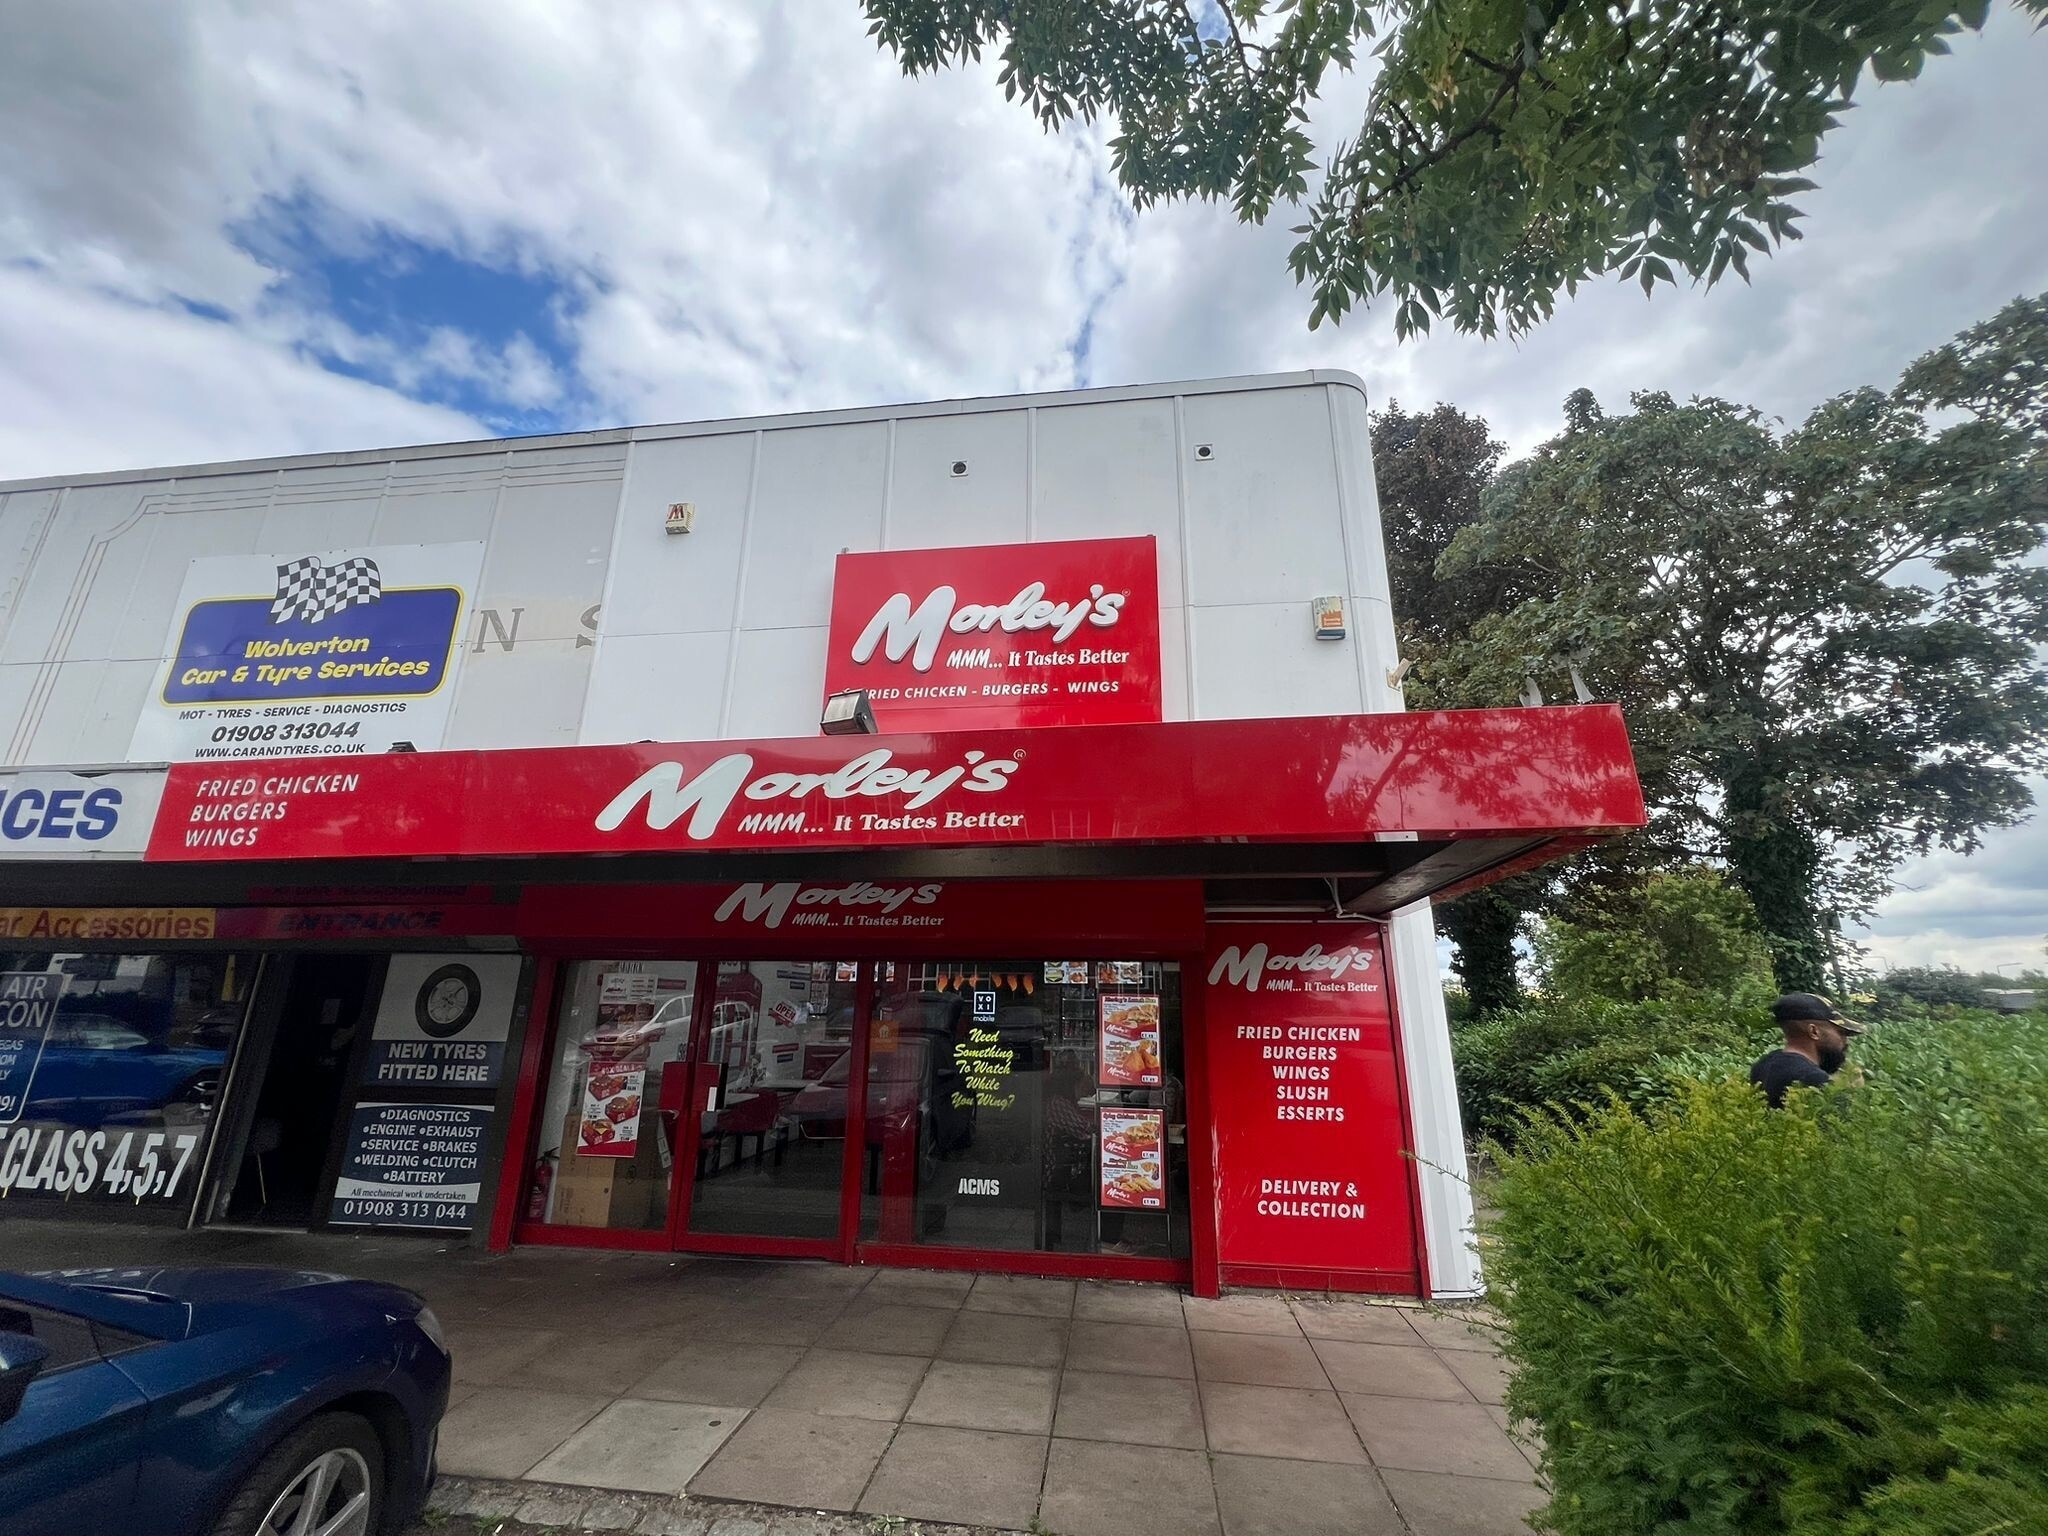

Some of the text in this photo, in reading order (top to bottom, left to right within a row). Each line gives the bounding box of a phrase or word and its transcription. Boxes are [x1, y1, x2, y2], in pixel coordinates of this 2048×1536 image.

[472, 608, 525, 653] N
[851, 581, 1126, 673] Morley's
[244, 636, 370, 658] Wolverton
[946, 648, 1130, 669] MMM... It Tastes Better
[181, 657, 430, 686] Car & Tyre Services
[865, 687, 900, 700] RIED
[904, 686, 967, 698] CHICKEN
[982, 683, 1048, 696] BURGERS
[1067, 681, 1120, 693] WINGS
[179, 710, 205, 720] MOT
[217, 709, 251, 719] TYRES
[263, 706, 311, 717] SERVICE
[323, 703, 407, 714] DIAGNOSTICS
[211, 721, 361, 743] 01908 313044
[195, 744, 365, 758] WWW.CARANDTYRES.CO.UK
[197, 774, 359, 798] FRIED CHICKEN
[594, 748, 1018, 840] Morley's
[190, 802, 287, 822] BURGERS
[738, 811, 1024, 834] MMM... It Tastes Better
[184, 828, 259, 847] WINGS
[714, 882, 943, 929] Morleys
[29, 910, 211, 939] Accessories
[277, 910, 444, 931] ENTRANCE
[843, 915, 854, 926] It
[857, 914, 899, 926] Tastes
[902, 914, 944, 926] Better
[1207, 942, 1374, 992] Morley's
[4, 976, 47, 999] AIR
[1304, 982, 1313, 992] It
[1315, 981, 1346, 992] Tastes
[1347, 982, 1378, 993] Better
[969, 1028, 1000, 1043] Need
[1236, 1025, 1361, 1041] FRIED CHICKEN
[388, 1043, 487, 1060] NEW TYRES
[953, 1043, 1014, 1063] Something
[1262, 1046, 1337, 1061] BURGERS
[377, 1064, 489, 1082] FITTED HERE
[956, 1060, 1011, 1075] To Watch
[1272, 1066, 1330, 1080] WINGS
[965, 1076, 1000, 1090] While
[951, 1091, 1015, 1111] You Wing?
[1276, 1086, 1329, 1100] SLUSH
[386, 1109, 471, 1122] DIAGNOSTICS
[1277, 1106, 1345, 1122] ESSERTS
[369, 1124, 482, 1138] ENGINE EXHAUST
[367, 1139, 478, 1153] SERVICE BRAKES
[0, 1127, 198, 1198] CLASS 4,5,7
[361, 1154, 478, 1169] WELDING CLUTCH
[390, 1171, 447, 1183] BATTERY
[958, 1177, 1000, 1196] ACMS
[351, 1188, 466, 1200] All mechanical work undertaken
[1261, 1179, 1359, 1197] DELIVERY &
[343, 1200, 467, 1219] 01908 313 044
[1257, 1200, 1365, 1219] COLLECTION
